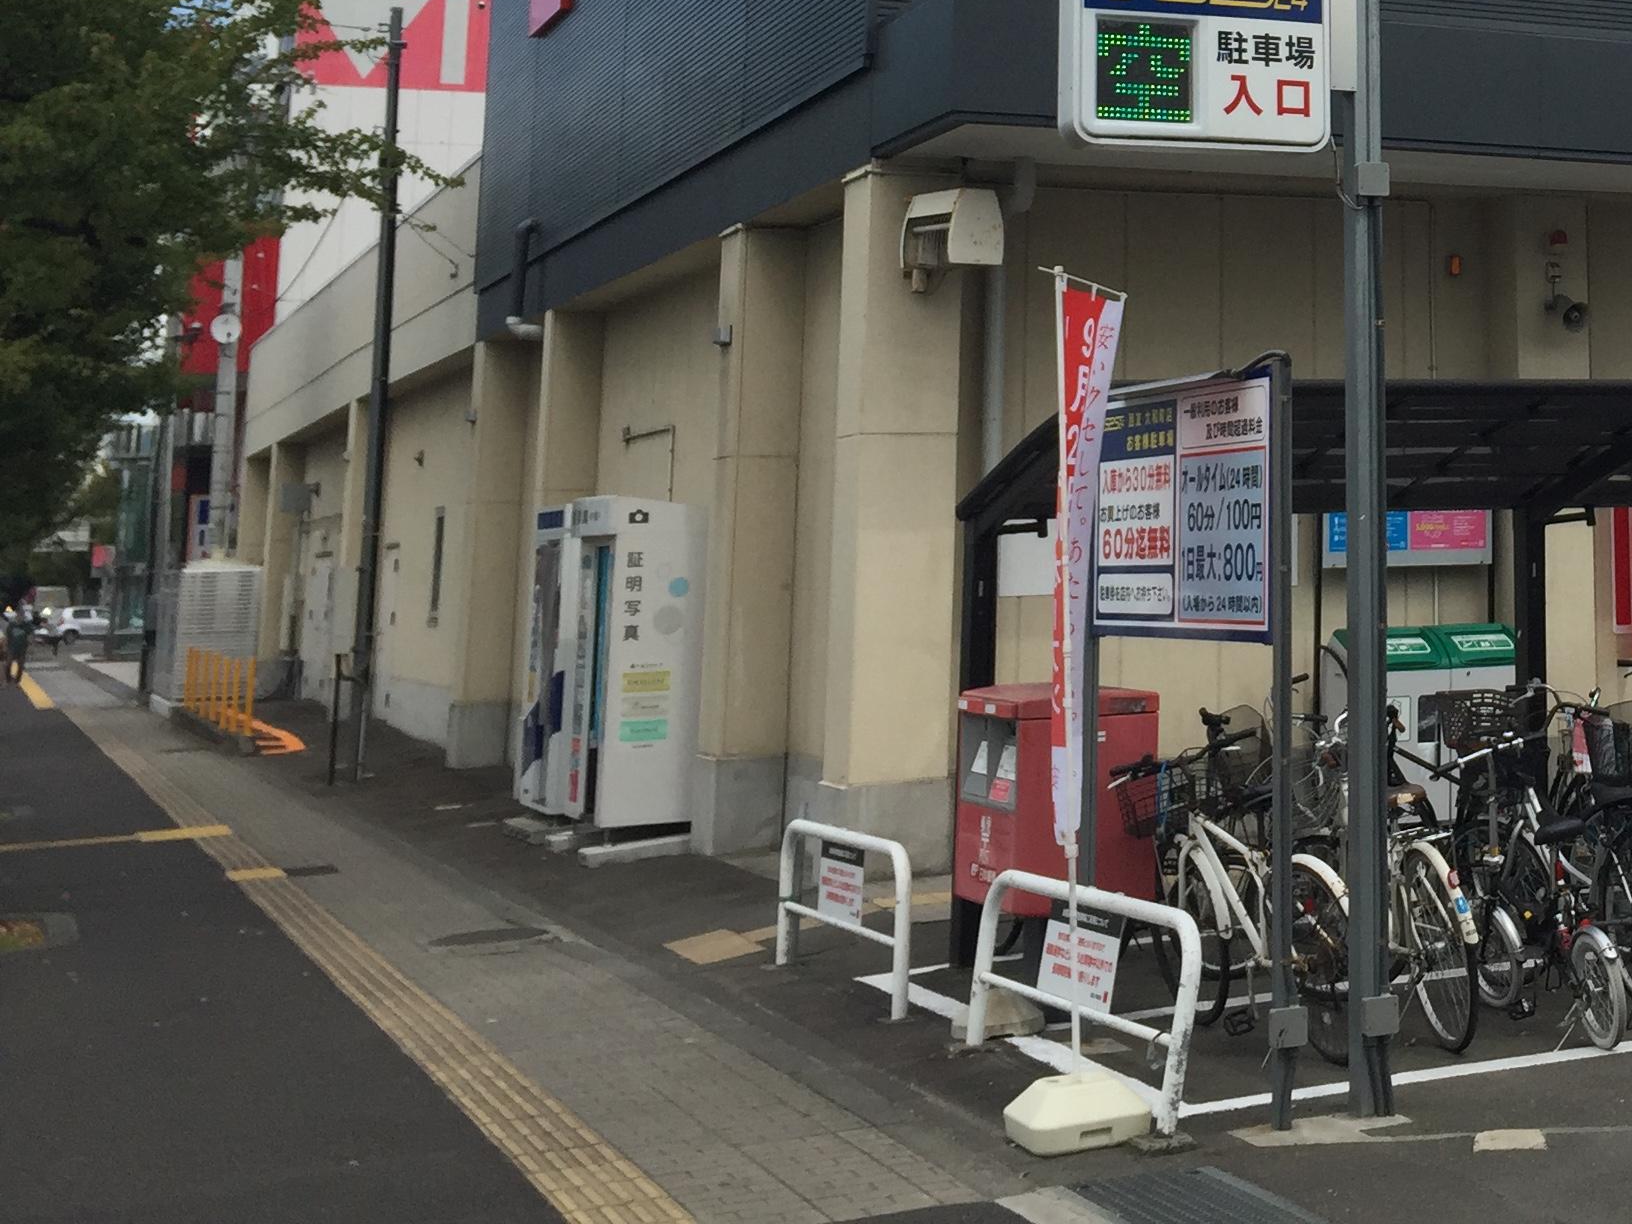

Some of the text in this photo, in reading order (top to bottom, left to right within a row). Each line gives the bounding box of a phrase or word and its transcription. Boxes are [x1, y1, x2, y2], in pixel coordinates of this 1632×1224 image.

[1097, 23, 1191, 121] 空
[1216, 30, 1315, 70] 駐車場
[1223, 73, 1312, 118] 入口
[622, 551, 645, 642] 証明写真
